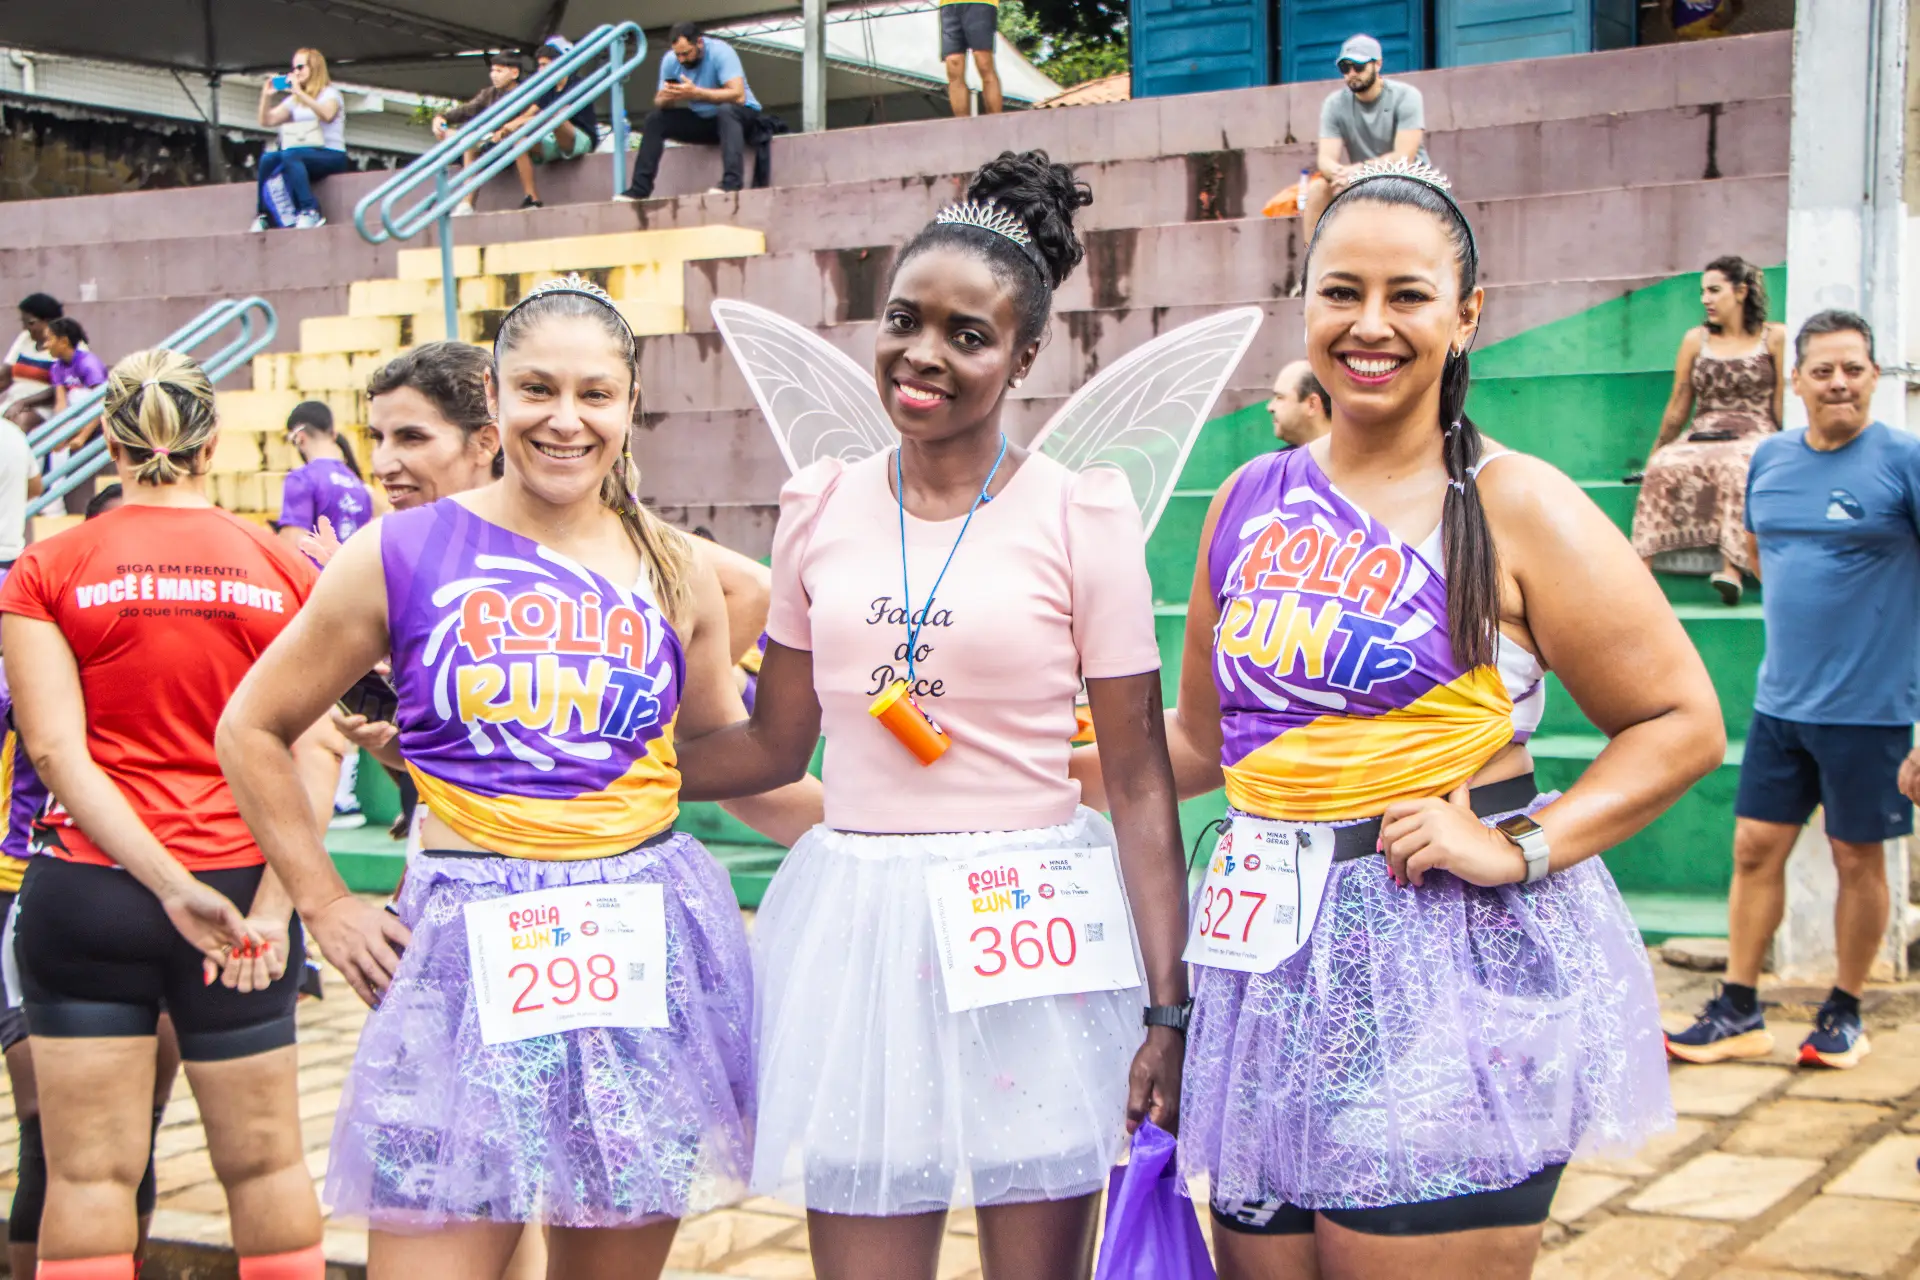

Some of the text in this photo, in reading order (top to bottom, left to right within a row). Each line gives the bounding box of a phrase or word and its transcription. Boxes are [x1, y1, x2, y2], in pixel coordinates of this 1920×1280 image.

[116, 564, 248, 578] SIGA EM FRENTE!
[75, 573, 285, 614] VOCÊ É MAIS FORTE
[119, 606, 140, 618] do
[143, 606, 171, 617] que
[866, 596, 954, 627] Fada
[894, 630, 934, 662] do
[1265, 838, 1290, 846] GERAIS
[1266, 831, 1287, 839] MINAS
[1200, 885, 1267, 943] 327
[969, 917, 1077, 978] 360
[508, 953, 619, 1014] 298
